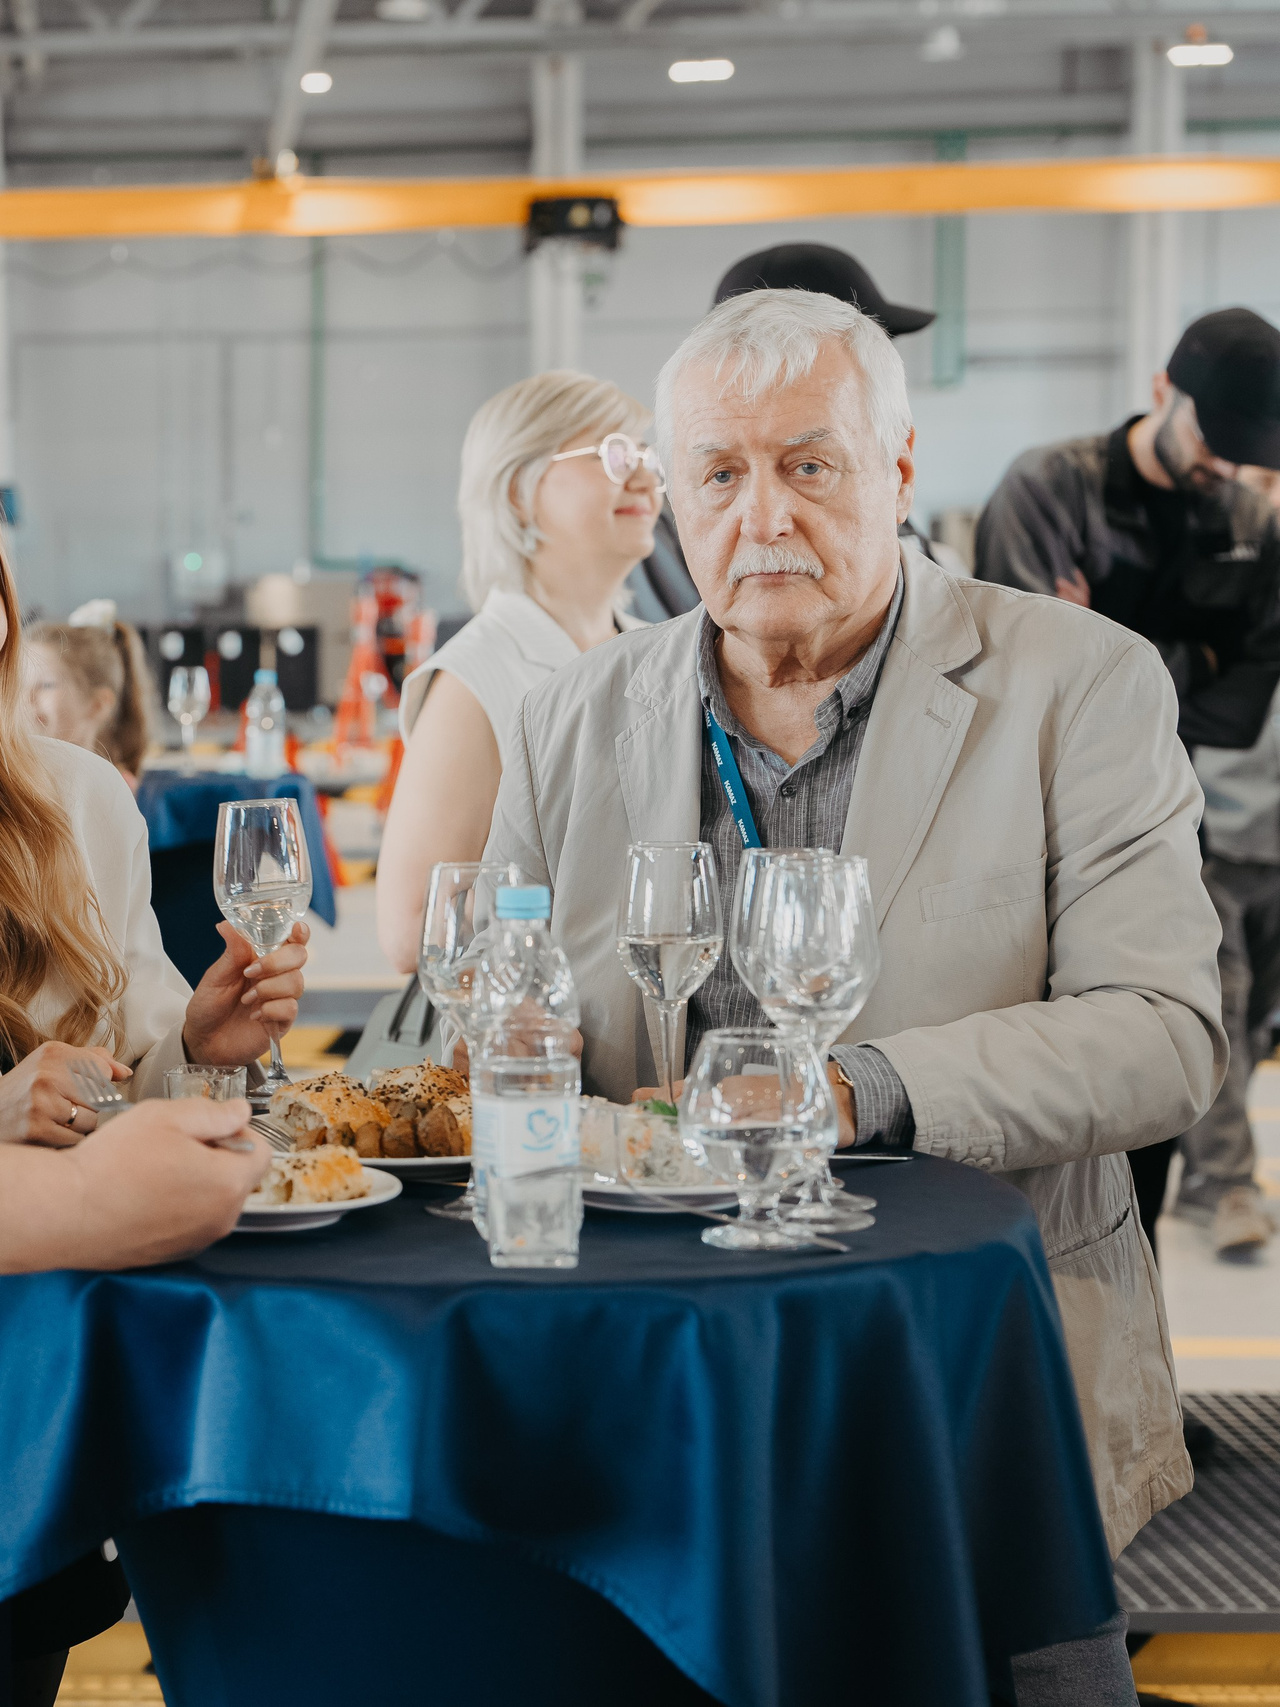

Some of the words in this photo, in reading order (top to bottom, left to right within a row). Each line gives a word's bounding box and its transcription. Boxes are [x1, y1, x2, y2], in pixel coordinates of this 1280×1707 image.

[711, 741, 724, 768] KAMAZ
[723, 779, 737, 806] KAMAZ
[737, 818, 750, 845] KAMAZ
